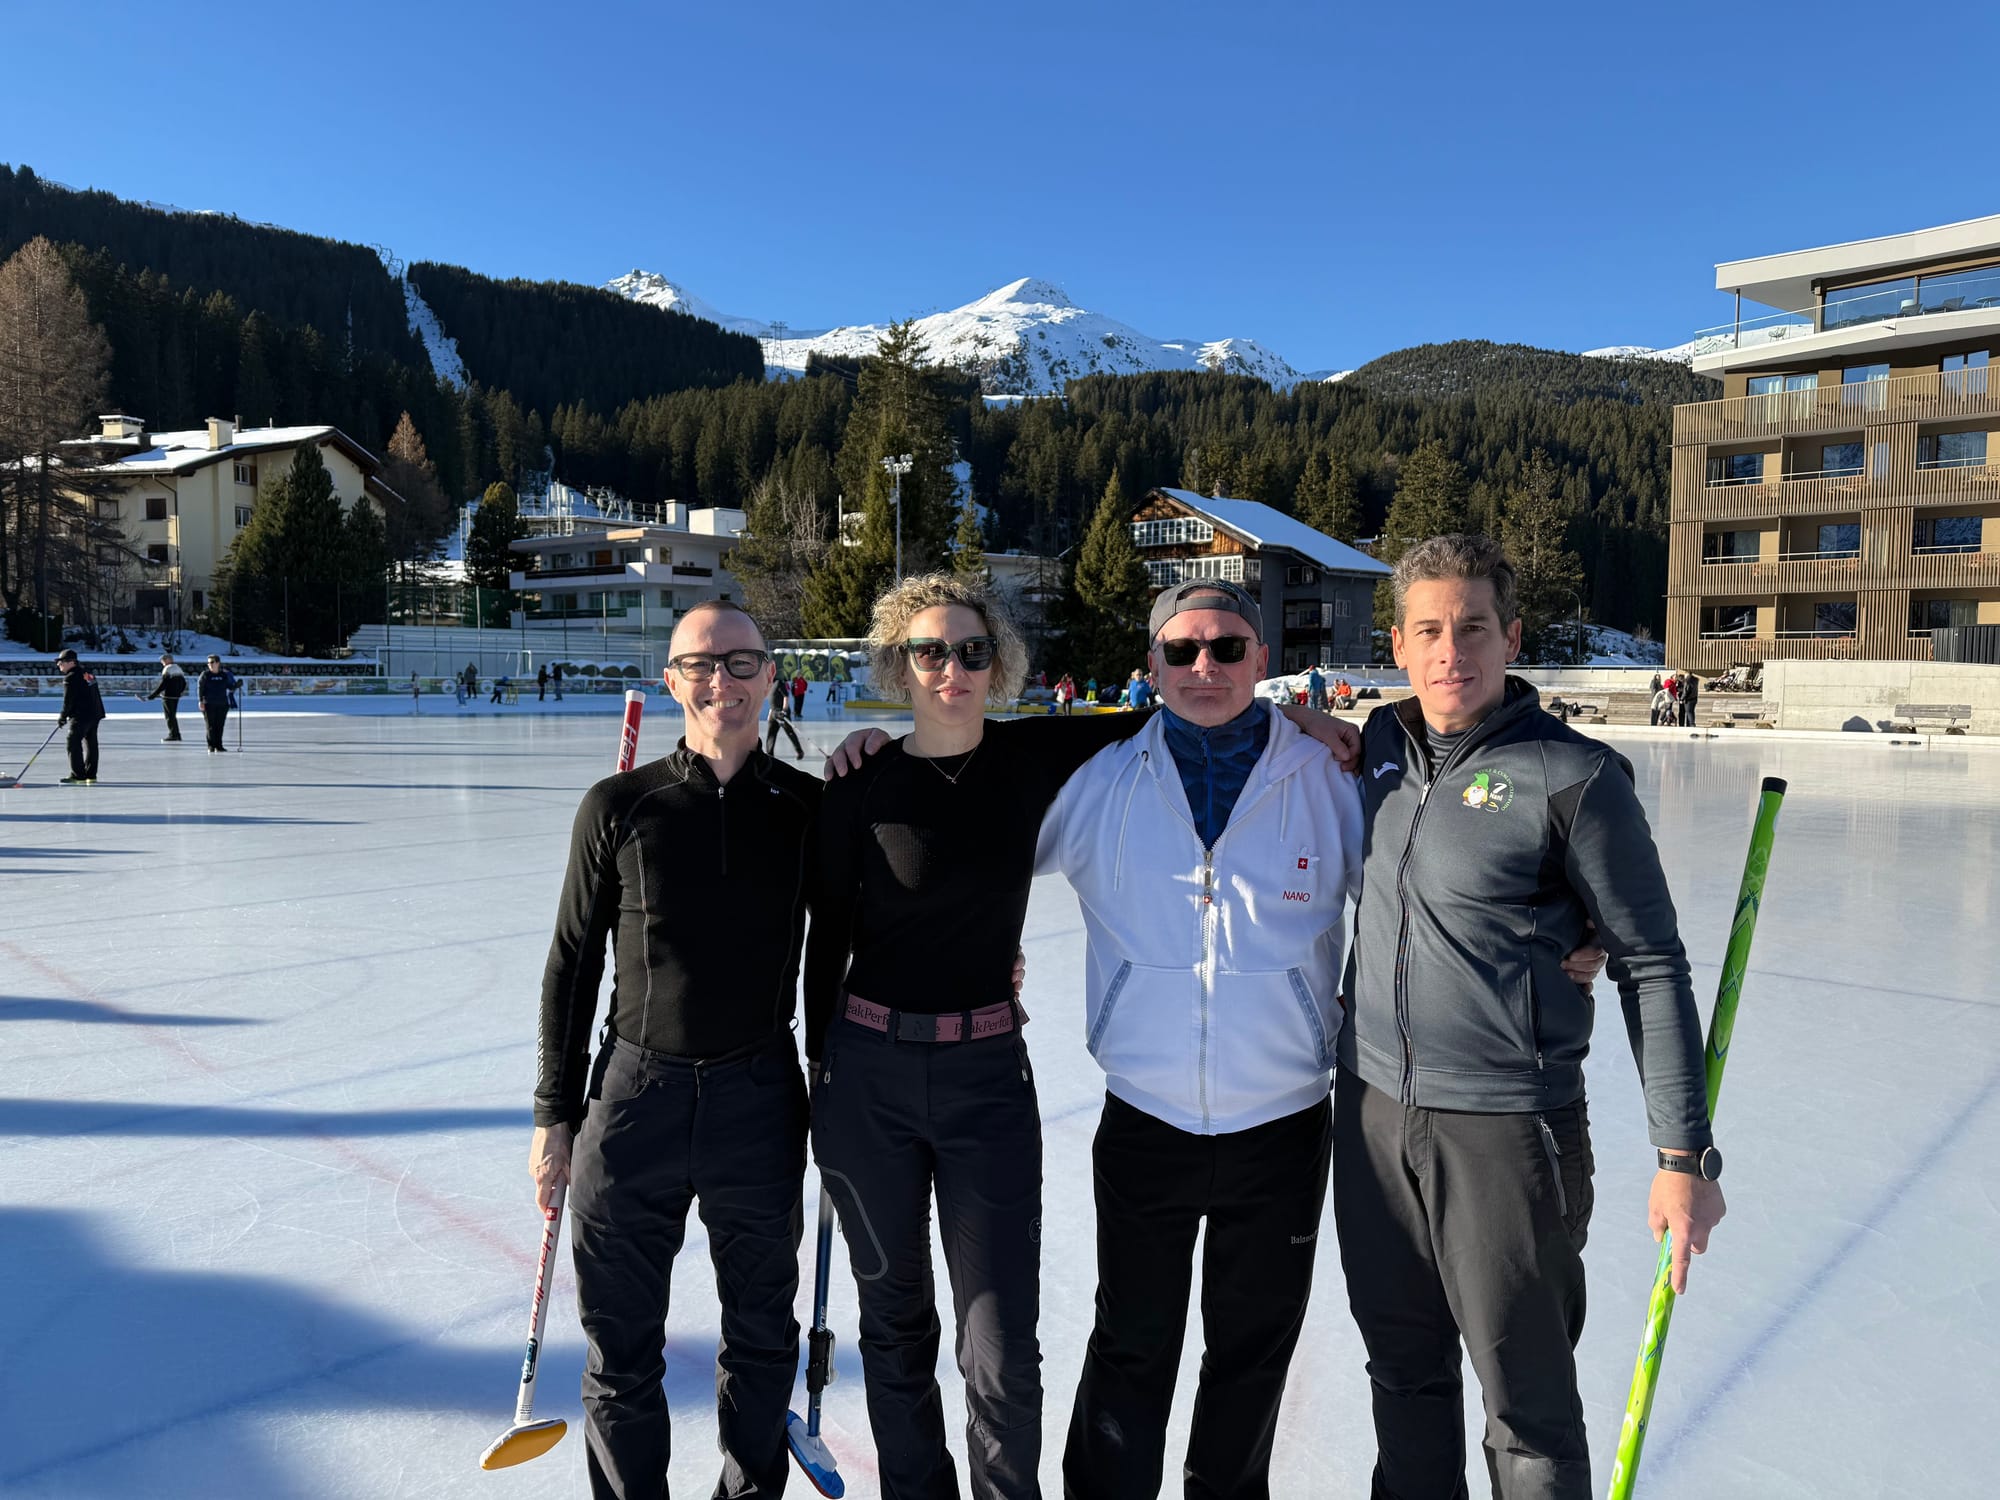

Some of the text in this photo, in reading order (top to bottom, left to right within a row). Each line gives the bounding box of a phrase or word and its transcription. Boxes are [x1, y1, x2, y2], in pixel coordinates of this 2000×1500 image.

[620, 723, 637, 772] Har
[1282, 890, 1311, 903] NANO
[847, 1003, 889, 1025] eakPerf
